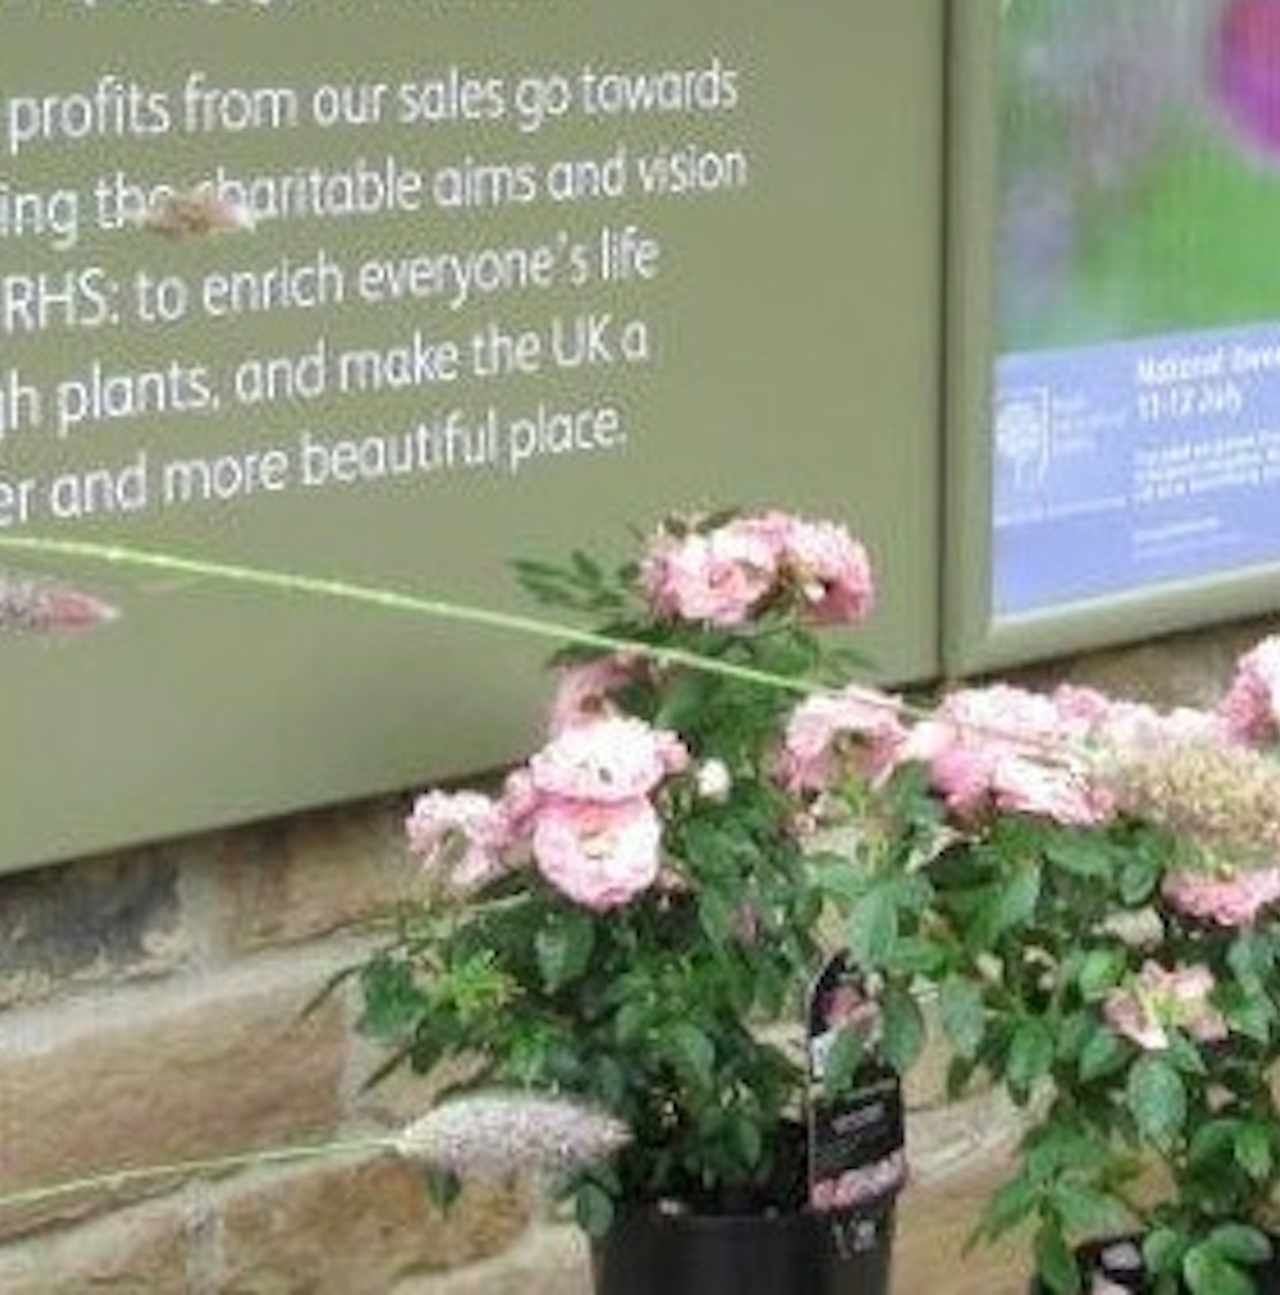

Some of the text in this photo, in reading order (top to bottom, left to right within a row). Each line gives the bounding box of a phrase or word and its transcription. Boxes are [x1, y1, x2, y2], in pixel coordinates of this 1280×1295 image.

[8, 79, 170, 153] profits
[184, 73, 297, 138] from
[313, 79, 390, 125] our
[399, 67, 505, 122] sales
[515, 71, 570, 131] go
[581, 59, 738, 116] towards
[433, 162, 535, 211] aims
[548, 146, 624, 200] and
[637, 143, 747, 194] vision
[3, 271, 119, 333] RHS:
[136, 269, 185, 322] to
[203, 251, 344, 314] enrich
[600, 226, 658, 280] life
[56, 357, 220, 434] plants,
[235, 340, 325, 406] and
[338, 329, 459, 391] make
[473, 321, 540, 374] the
[551, 316, 612, 367] UK
[621, 324, 648, 363] a
[50, 447, 147, 518] and
[164, 430, 287, 503] more
[300, 407, 499, 486] beautiful
[509, 404, 628, 473] place.
